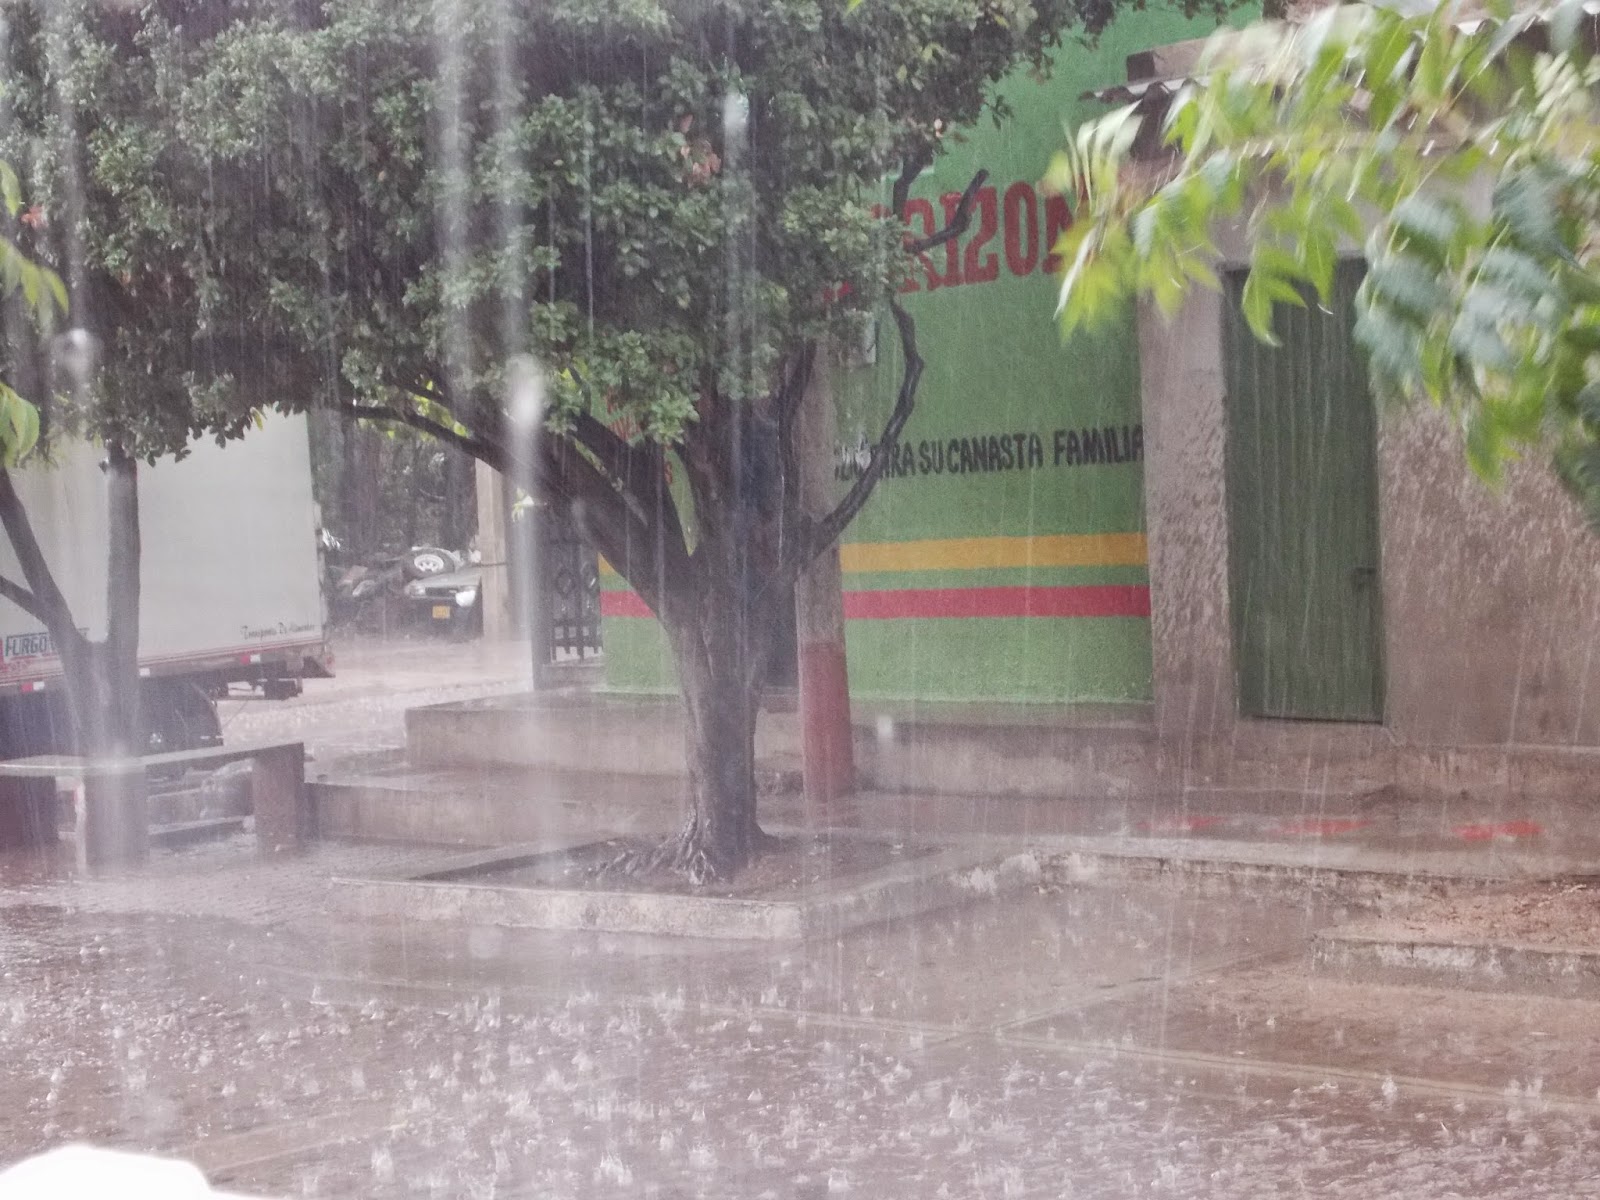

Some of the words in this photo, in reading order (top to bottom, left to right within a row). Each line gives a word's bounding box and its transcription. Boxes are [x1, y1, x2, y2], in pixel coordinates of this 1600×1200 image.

[919, 439, 944, 475] SU
[946, 434, 1042, 475] CANASTA
[5, 632, 58, 656] FURGO
